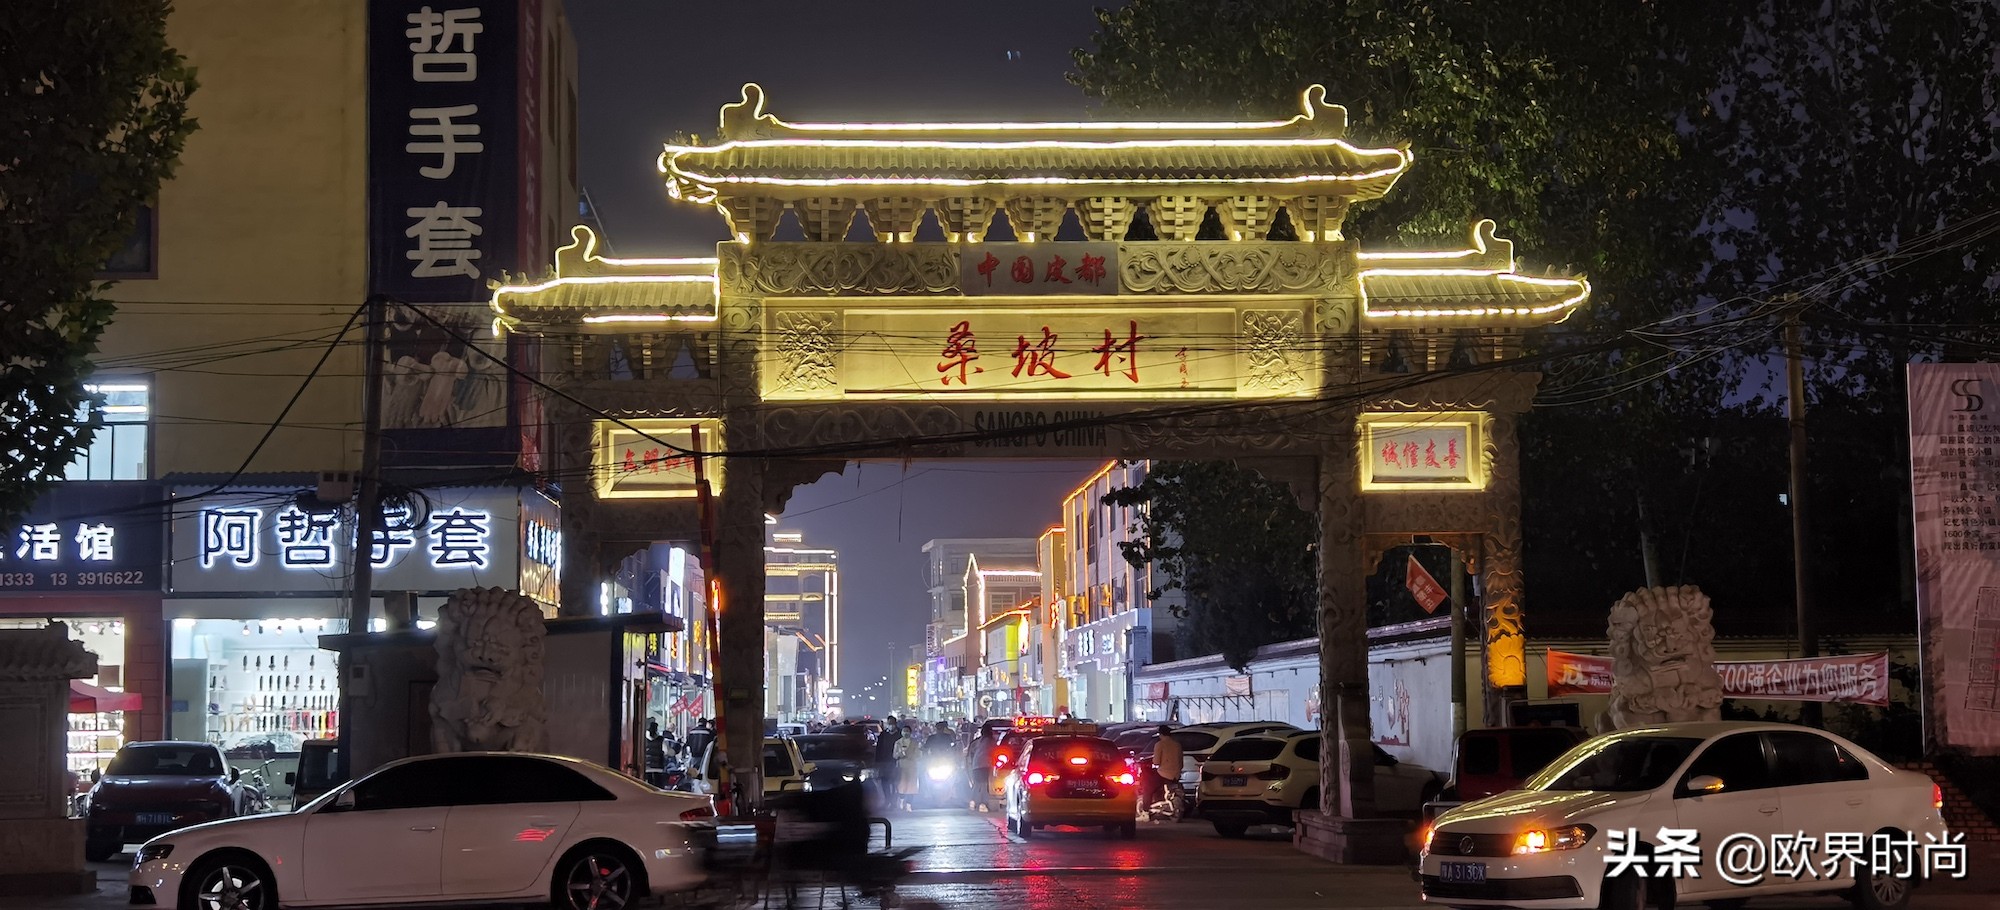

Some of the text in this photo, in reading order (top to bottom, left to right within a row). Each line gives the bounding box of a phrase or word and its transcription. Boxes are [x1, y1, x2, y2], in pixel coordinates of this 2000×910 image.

[405, 5, 485, 279] 哲手套
[976, 251, 1107, 286] 中国皮都
[937, 320, 1147, 386] 桑坡村
[975, 410, 1107, 447] SANGPO CHINA
[0, 522, 115, 561] 活馆
[203, 508, 488, 567] 阿哲手套
[77, 571, 144, 586] 3916622
